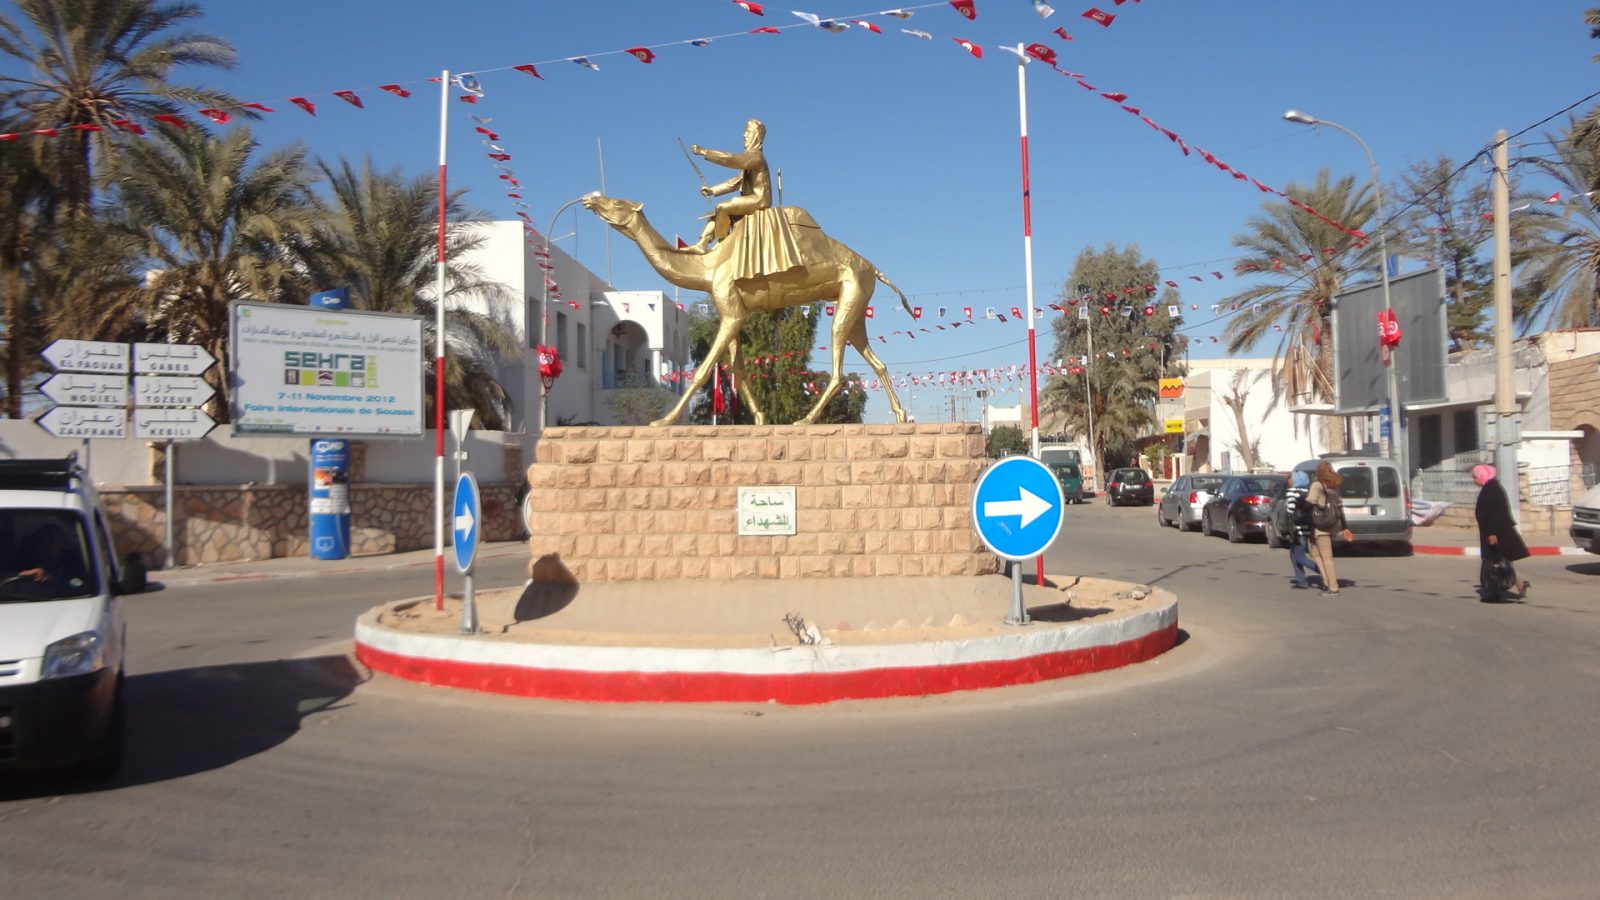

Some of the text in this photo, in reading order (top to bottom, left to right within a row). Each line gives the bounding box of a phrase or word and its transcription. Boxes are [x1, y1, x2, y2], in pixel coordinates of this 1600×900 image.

[139, 346, 198, 361] قابس
[60, 359, 124, 370] EL FAOUAR
[149, 363, 190, 371] GABES
[70, 394, 119, 403] NOUIEL
[146, 395, 192, 404] TOZEUR
[306, 392, 363, 402] Novembre
[366, 395, 397, 403] 2012
[359, 405, 373, 415] de
[375, 407, 416, 416] Sousse
[59, 427, 124, 437] ZAAFRANE
[149, 428, 191, 436] KEBILI
[750, 494, 784, 507] ساحة
[746, 513, 789, 529] الشهداء
